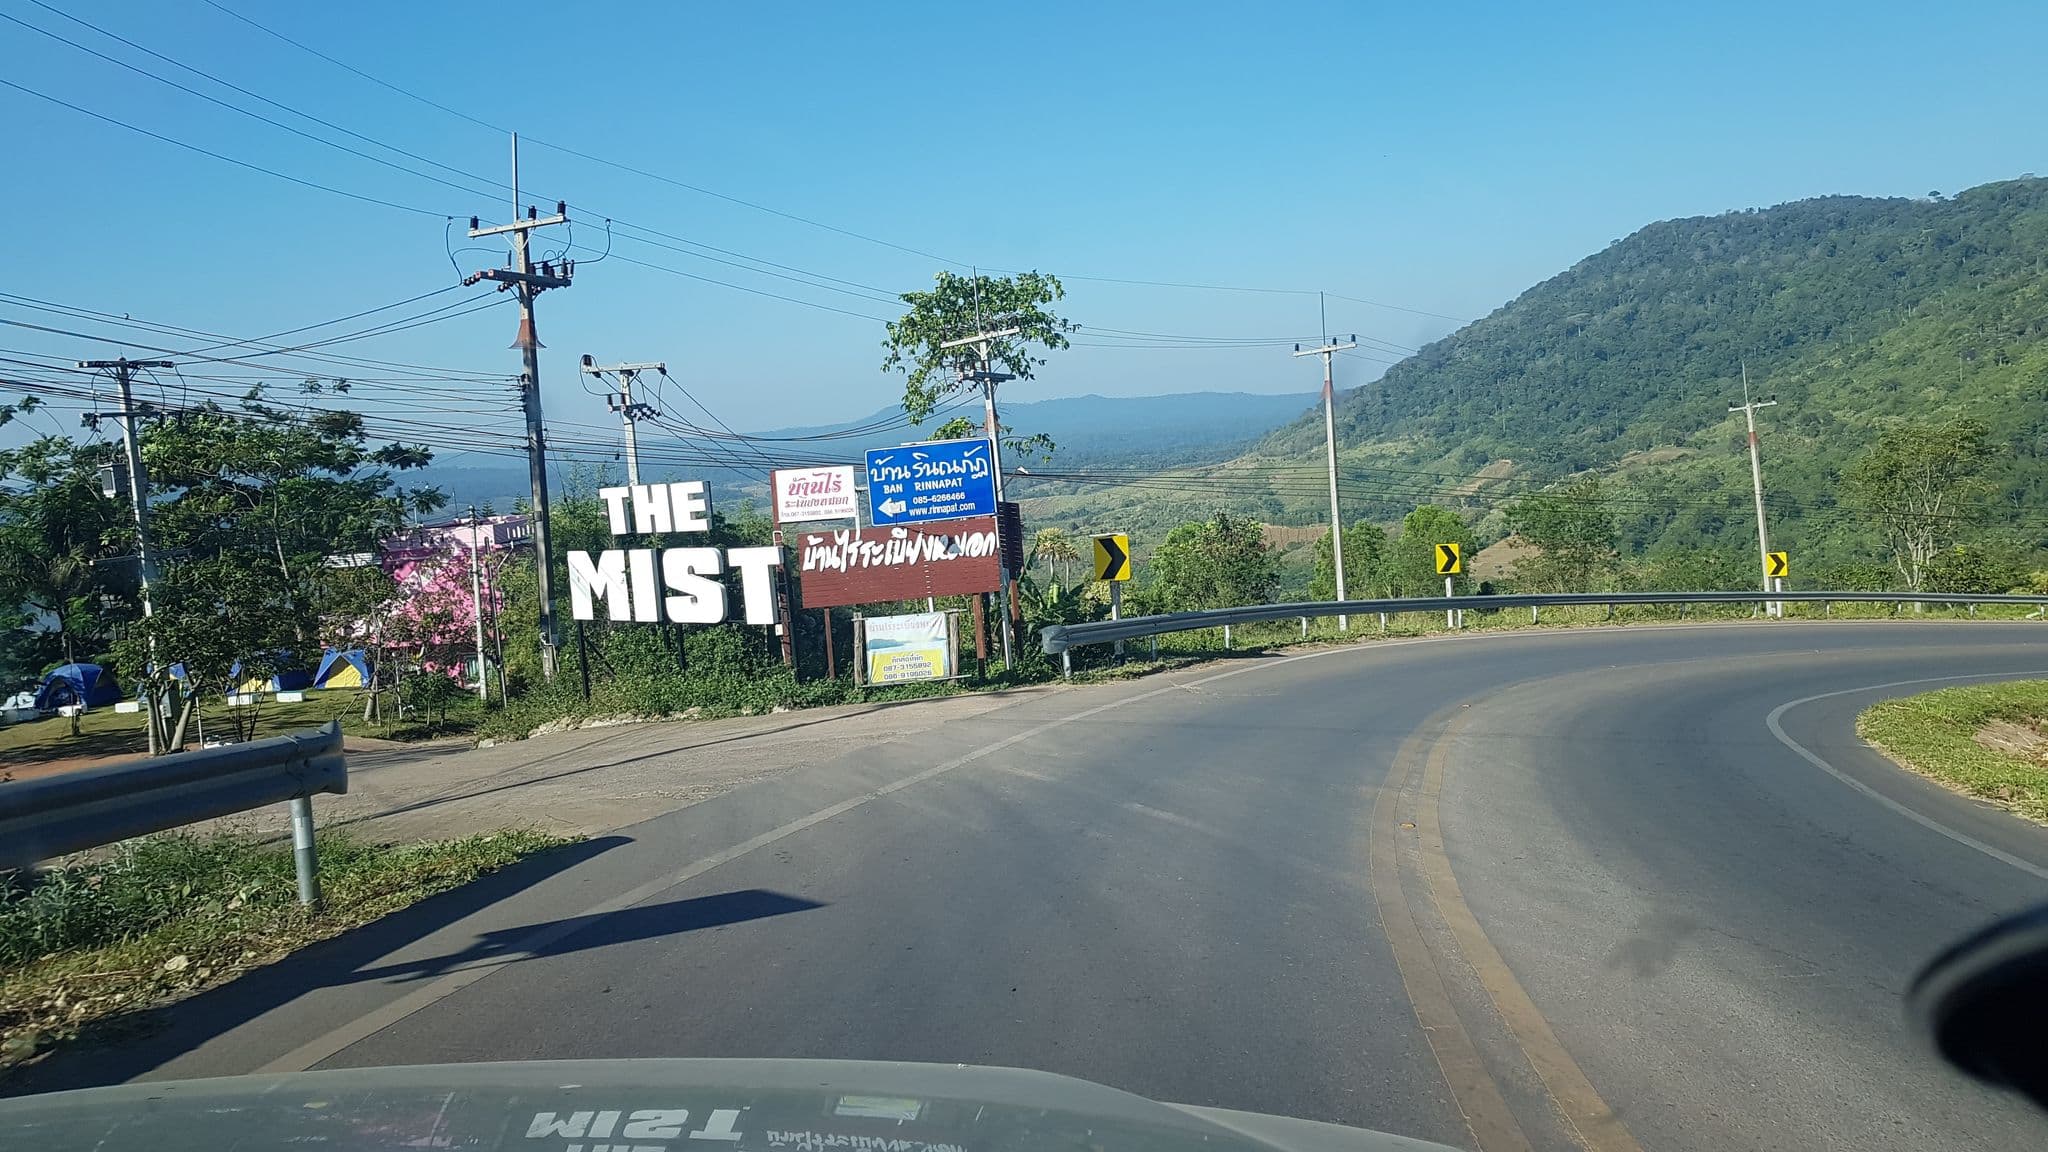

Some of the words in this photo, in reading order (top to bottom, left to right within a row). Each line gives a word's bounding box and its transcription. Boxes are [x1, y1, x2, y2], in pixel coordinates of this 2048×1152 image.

[870, 455, 911, 482] บ้าน
[883, 483, 904, 495] BAN
[914, 477, 964, 492] RINNAPAT
[599, 480, 713, 535] THE
[909, 501, 976, 517] www.rinnapat.com
[567, 546, 784, 625] MIST
